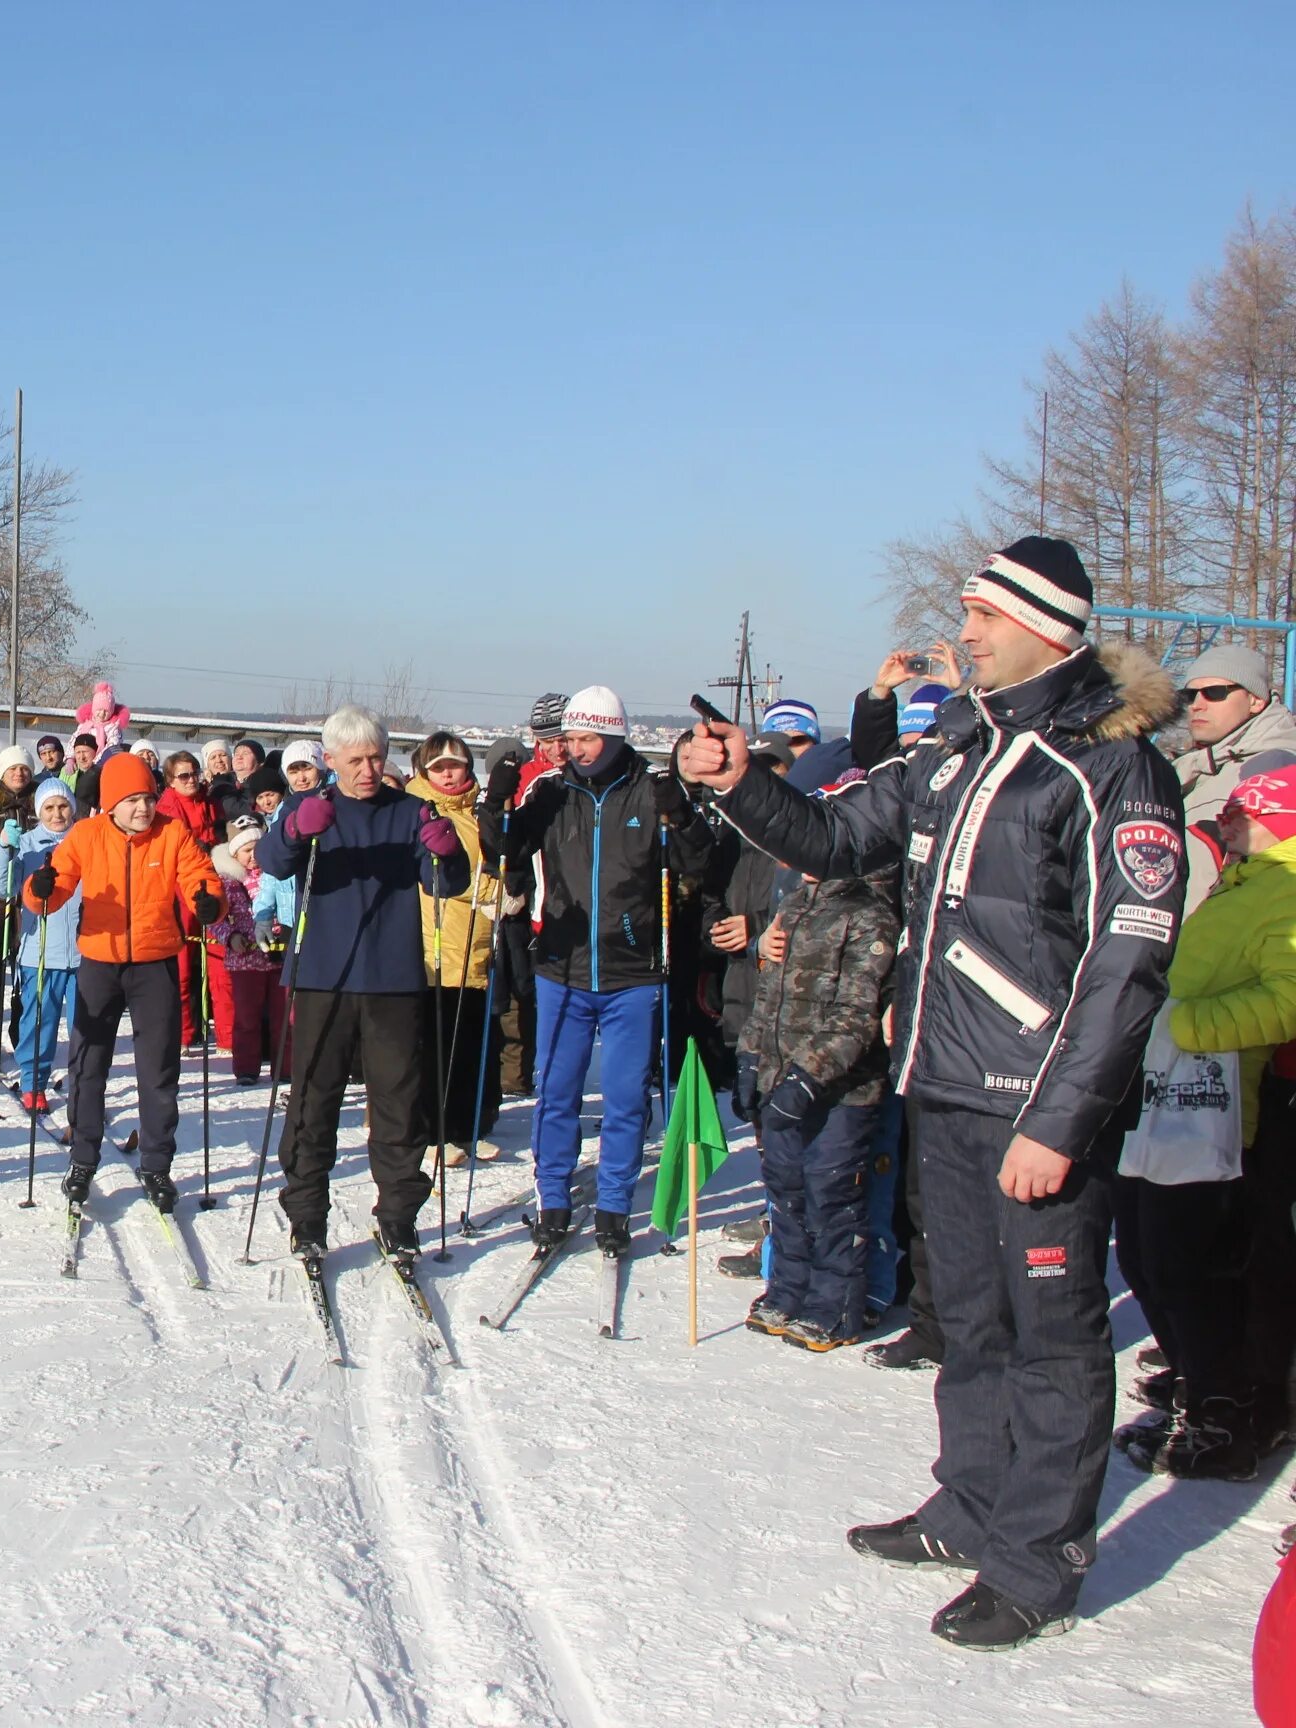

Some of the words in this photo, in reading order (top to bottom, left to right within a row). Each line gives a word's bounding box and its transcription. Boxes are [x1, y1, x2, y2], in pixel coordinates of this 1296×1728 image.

[1123, 800, 1176, 820] BOGNER
[954, 795, 986, 871] NORTH-WEST
[1120, 829, 1178, 853] POLAR
[1116, 907, 1171, 924] NORTH-WEST
[623, 913, 636, 946] adidas
[987, 1075, 1036, 1091] BOGNE
